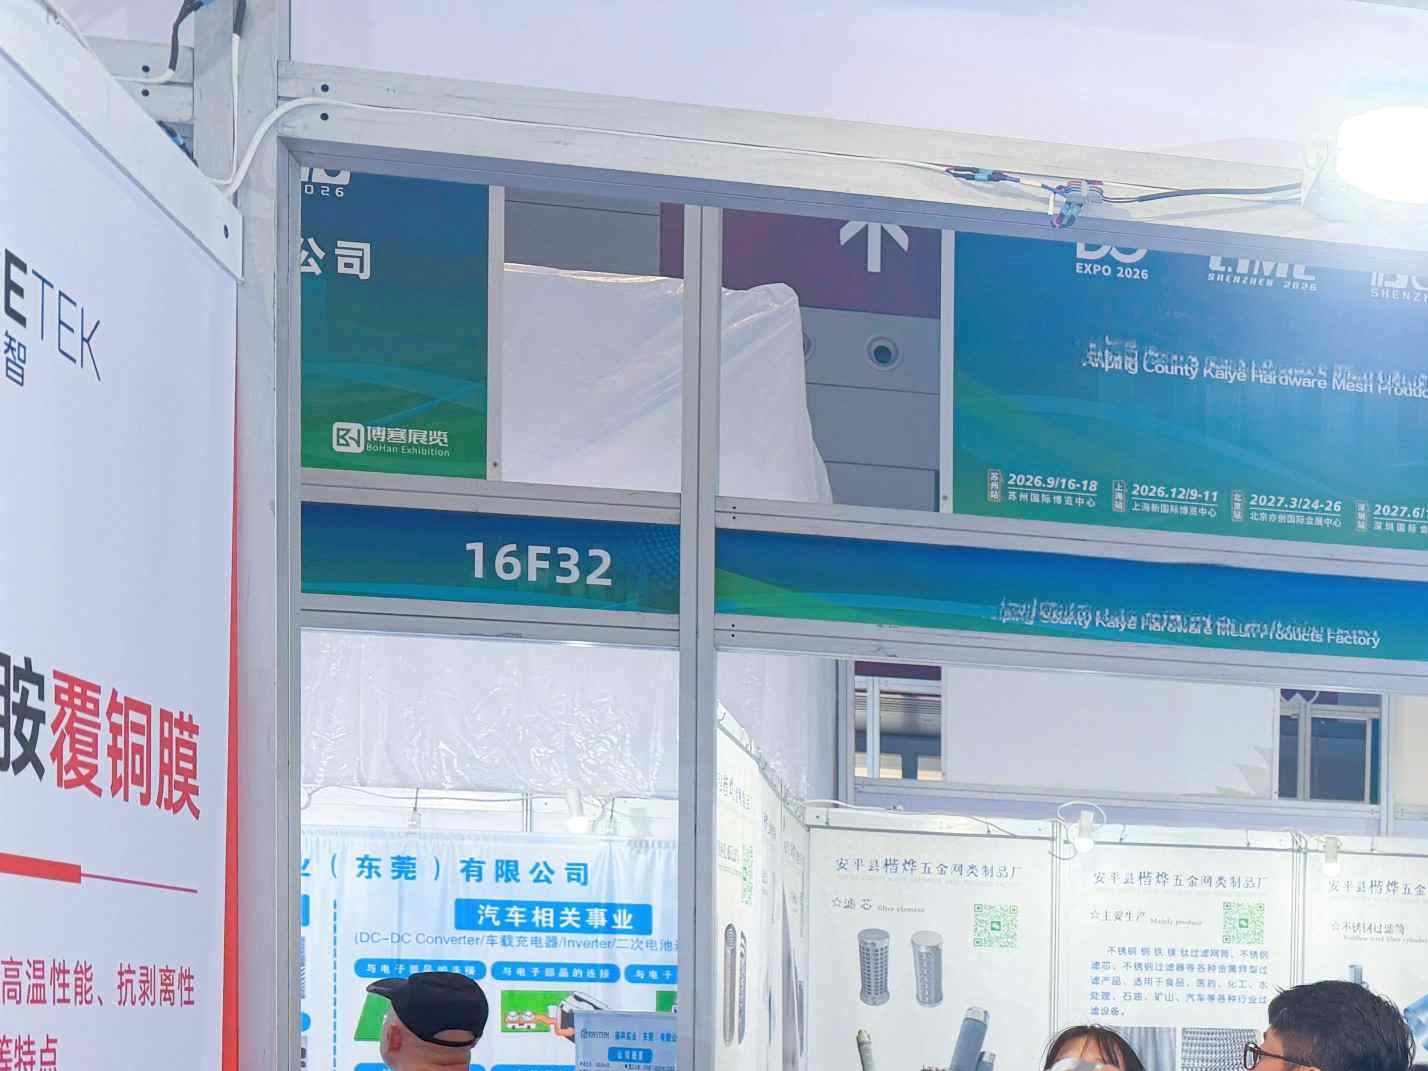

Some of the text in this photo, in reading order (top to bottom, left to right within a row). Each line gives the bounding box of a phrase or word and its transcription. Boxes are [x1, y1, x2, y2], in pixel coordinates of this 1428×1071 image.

[1076, 262, 1148, 280] EXPO 2026
[2, 330, 27, 387] 智
[401, 445, 450, 457] Exhibition
[1007, 473, 1098, 492] 2026.9/16-18
[1131, 483, 1219, 502] 2026.12/9-11
[1249, 494, 1342, 513] 2027.3/24-26
[465, 541, 613, 586] 16F32
[477, 904, 634, 930] 汽车相关事业
[0, 956, 196, 1008] 高温性能、抗剥离性
